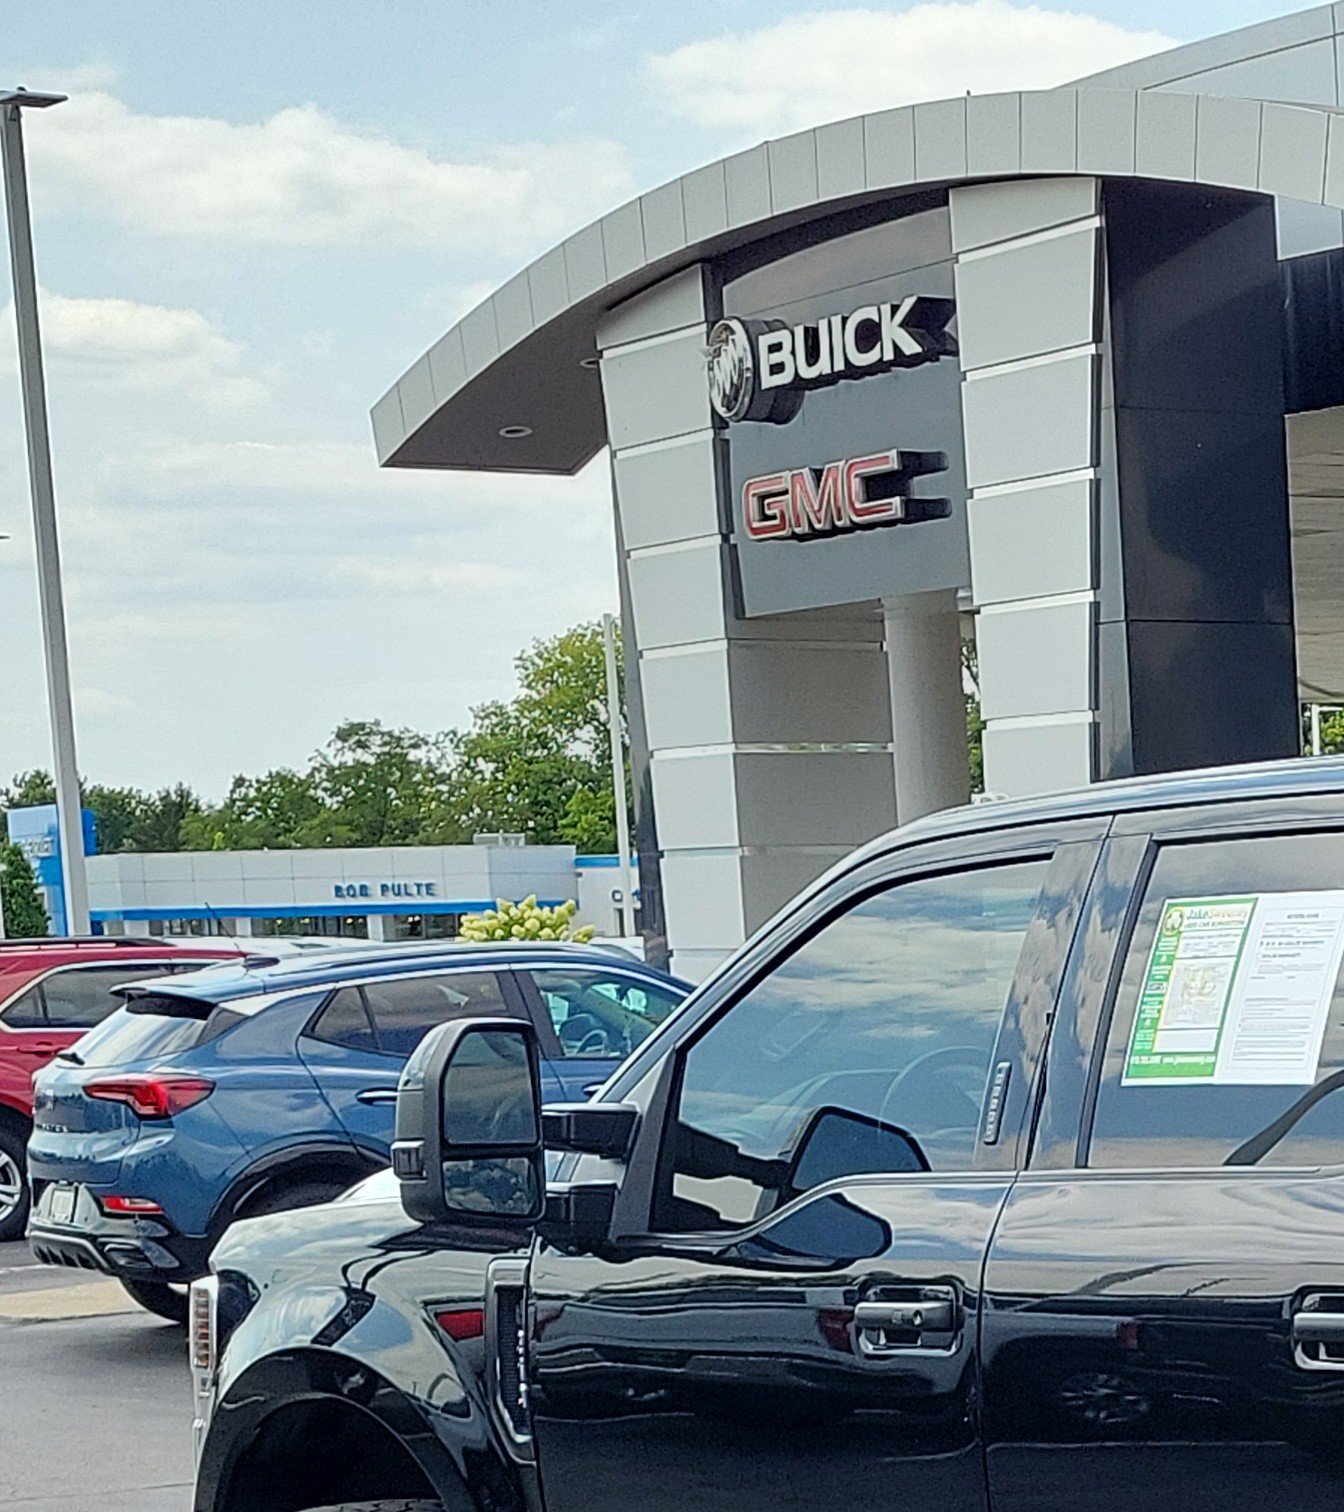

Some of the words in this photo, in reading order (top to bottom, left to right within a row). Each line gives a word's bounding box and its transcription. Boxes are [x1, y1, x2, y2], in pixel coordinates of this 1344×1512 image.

[758, 294, 924, 390] BUICK
[743, 448, 906, 541] GMC
[334, 883, 369, 898] BOB
[380, 882, 437, 897] PULTE
